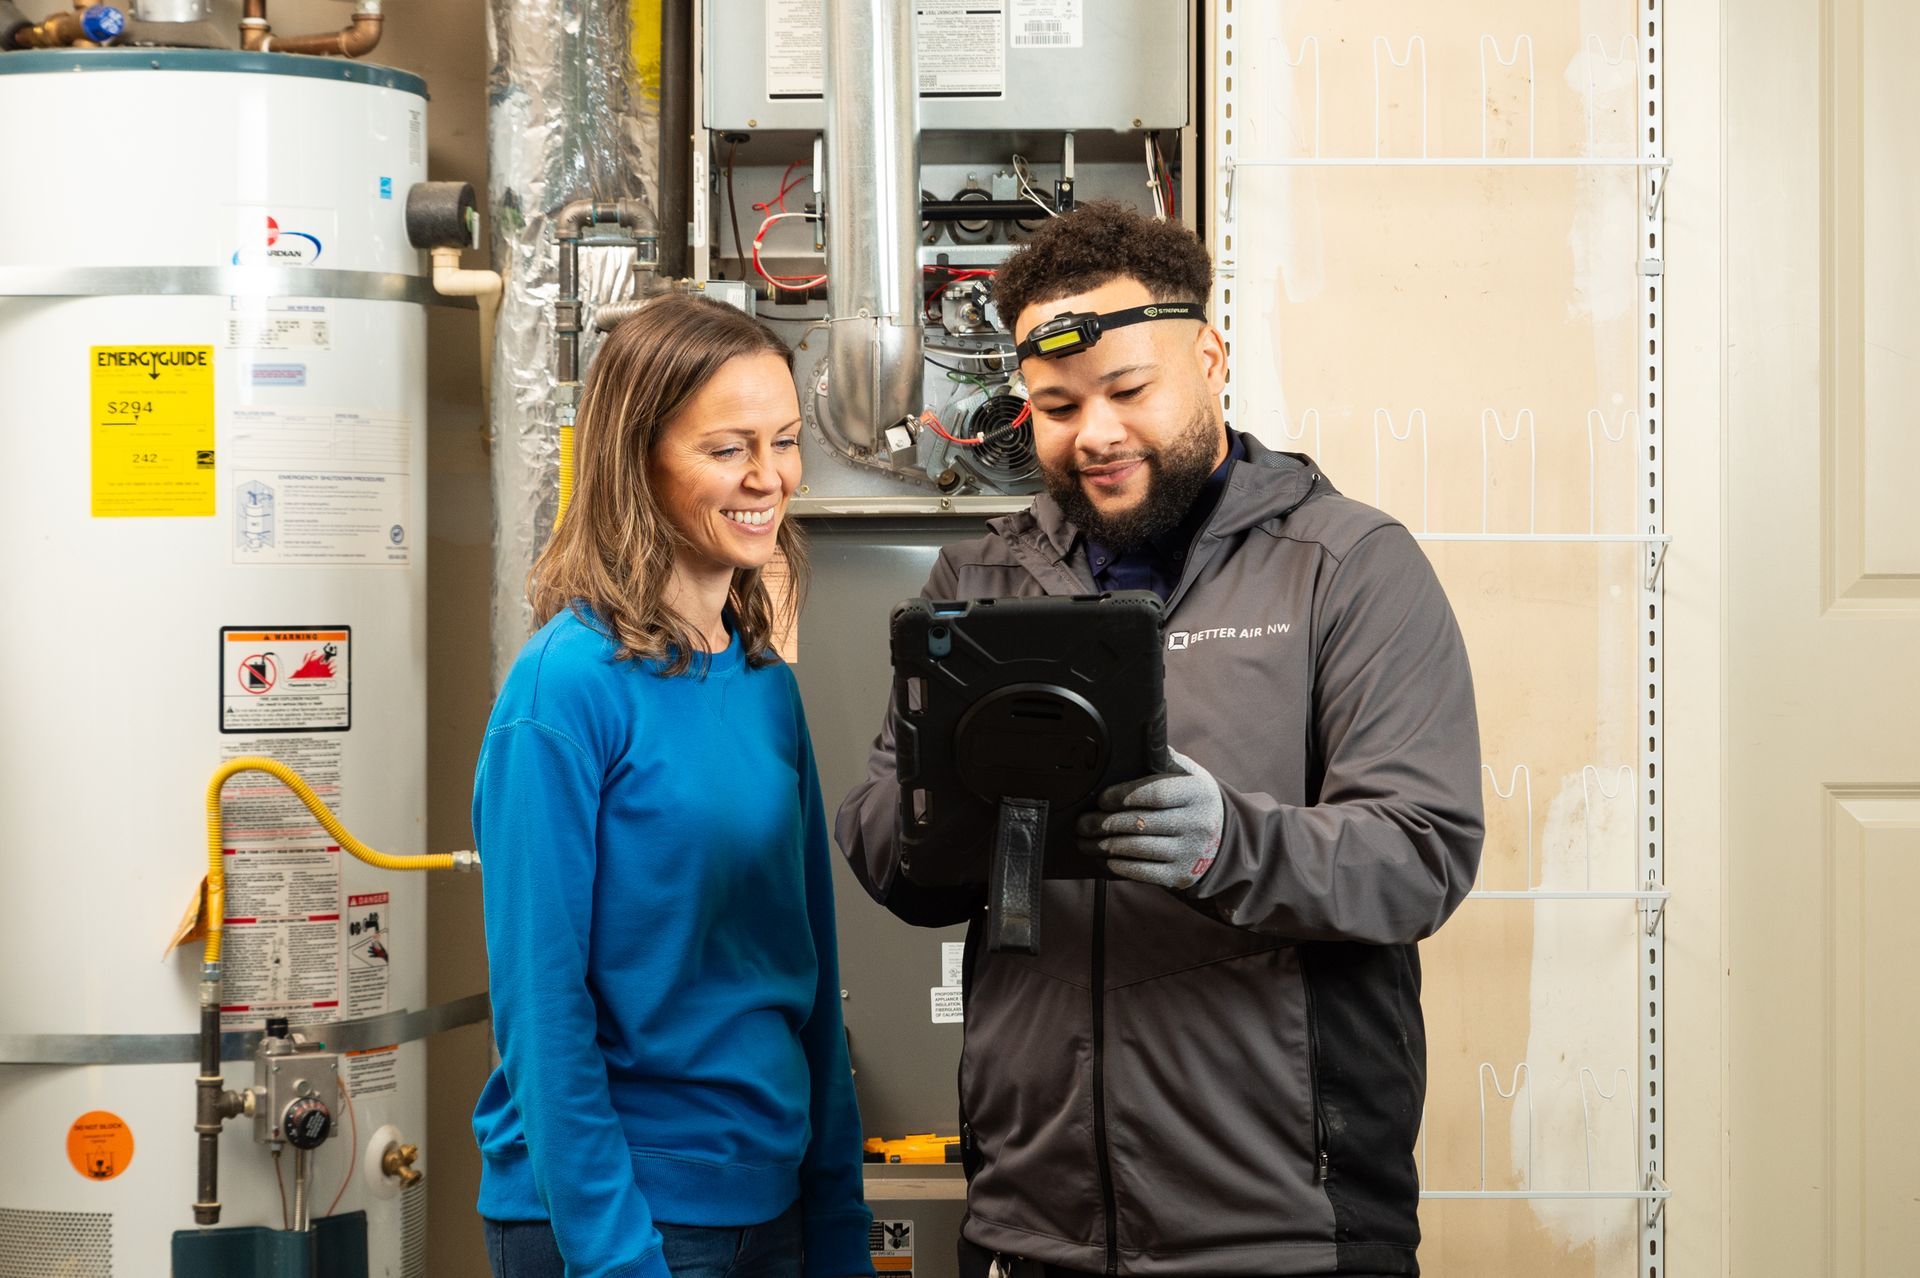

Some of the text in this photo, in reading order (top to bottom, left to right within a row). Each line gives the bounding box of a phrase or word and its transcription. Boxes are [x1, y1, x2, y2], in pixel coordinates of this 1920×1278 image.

[97, 351, 207, 367] ENERGYGUIDE
[132, 453, 158, 463] 242
[273, 633, 319, 641] WARNING
[1190, 623, 1291, 644] BETTER AIR NW
[358, 894, 387, 905] DANGER
